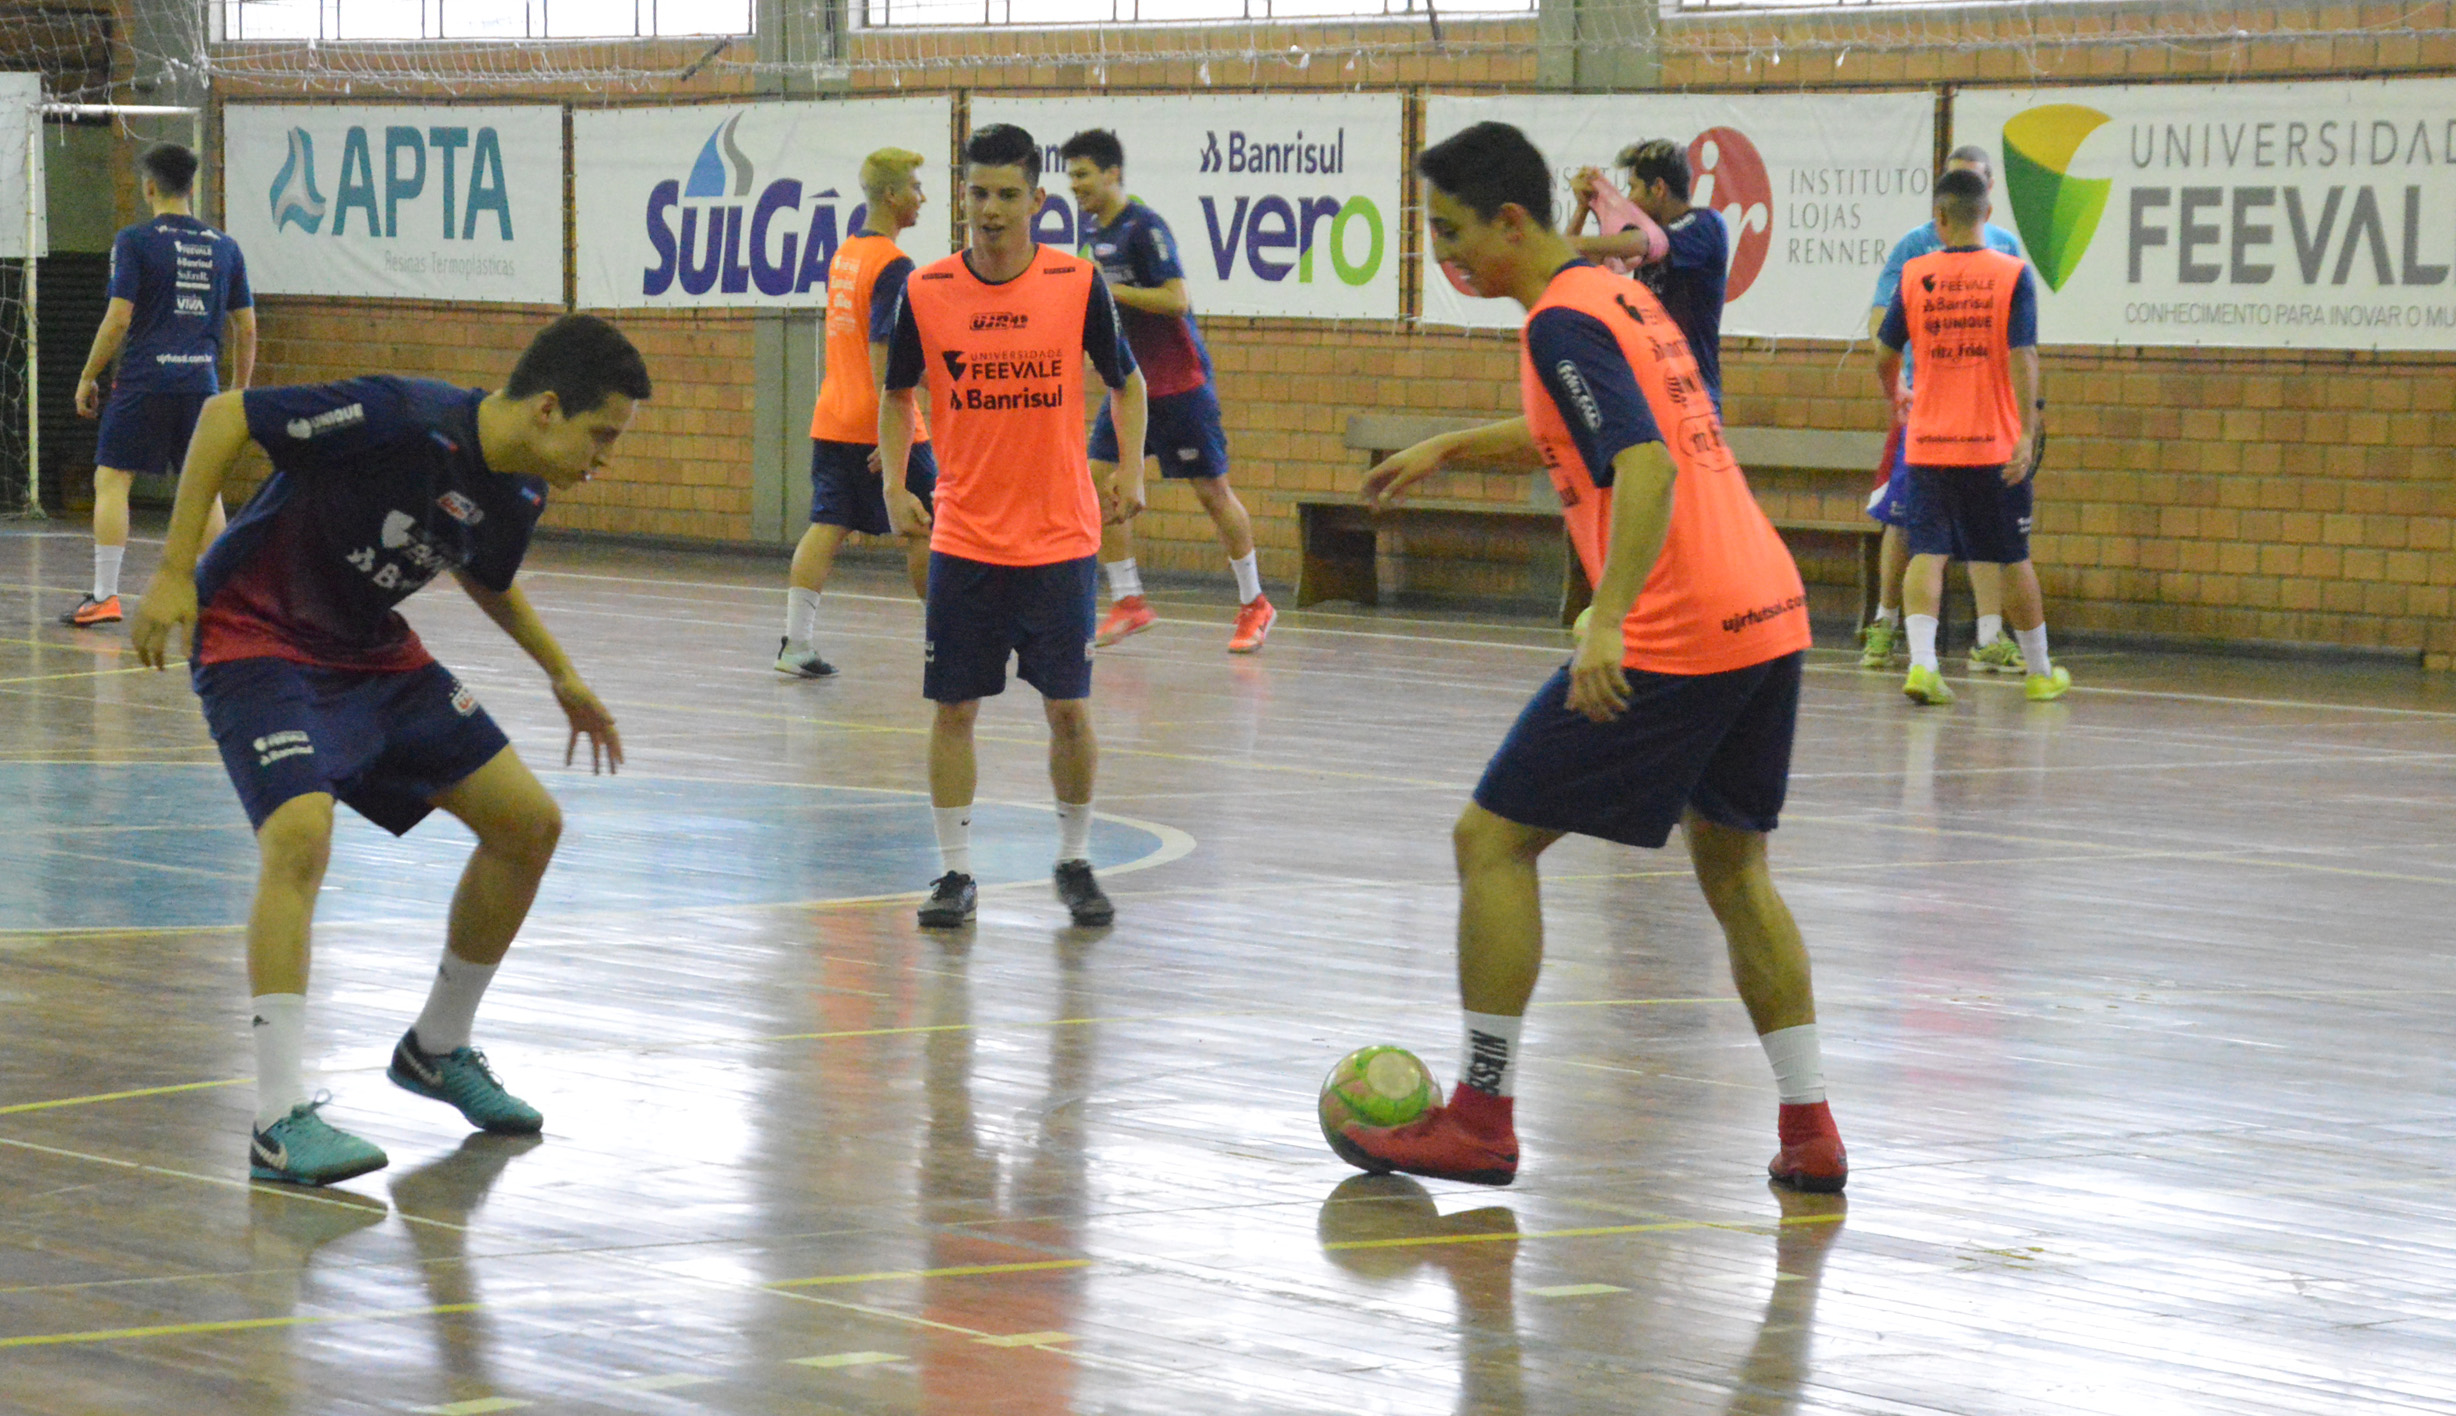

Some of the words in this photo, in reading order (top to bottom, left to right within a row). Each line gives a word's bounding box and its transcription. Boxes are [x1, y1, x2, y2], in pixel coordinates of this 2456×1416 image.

[1228, 127, 1344, 174] Banrisul
[331, 125, 514, 241] APTA
[1790, 167, 1929, 196] INSTITUTO
[1789, 203, 1861, 233] LOJAS
[643, 177, 867, 296] SULGÁ
[1198, 194, 1384, 286] vero
[2127, 185, 2456, 285] FEEVAL
[1788, 238, 1887, 266] RENNER
[1940, 279, 1995, 291] FEEVALE
[1937, 294, 1994, 311] Banrisul
[2125, 302, 2271, 325] CONHECIMENTO
[2275, 304, 2325, 325] PARA
[2330, 304, 2401, 327] INOVAR
[2407, 305, 2421, 327] O
[1943, 315, 1993, 329] UNIQUE
[970, 348, 1063, 362] UNIVERSIDADE
[971, 360, 1062, 381] FEEVALE
[966, 384, 1062, 411] Banrisul
